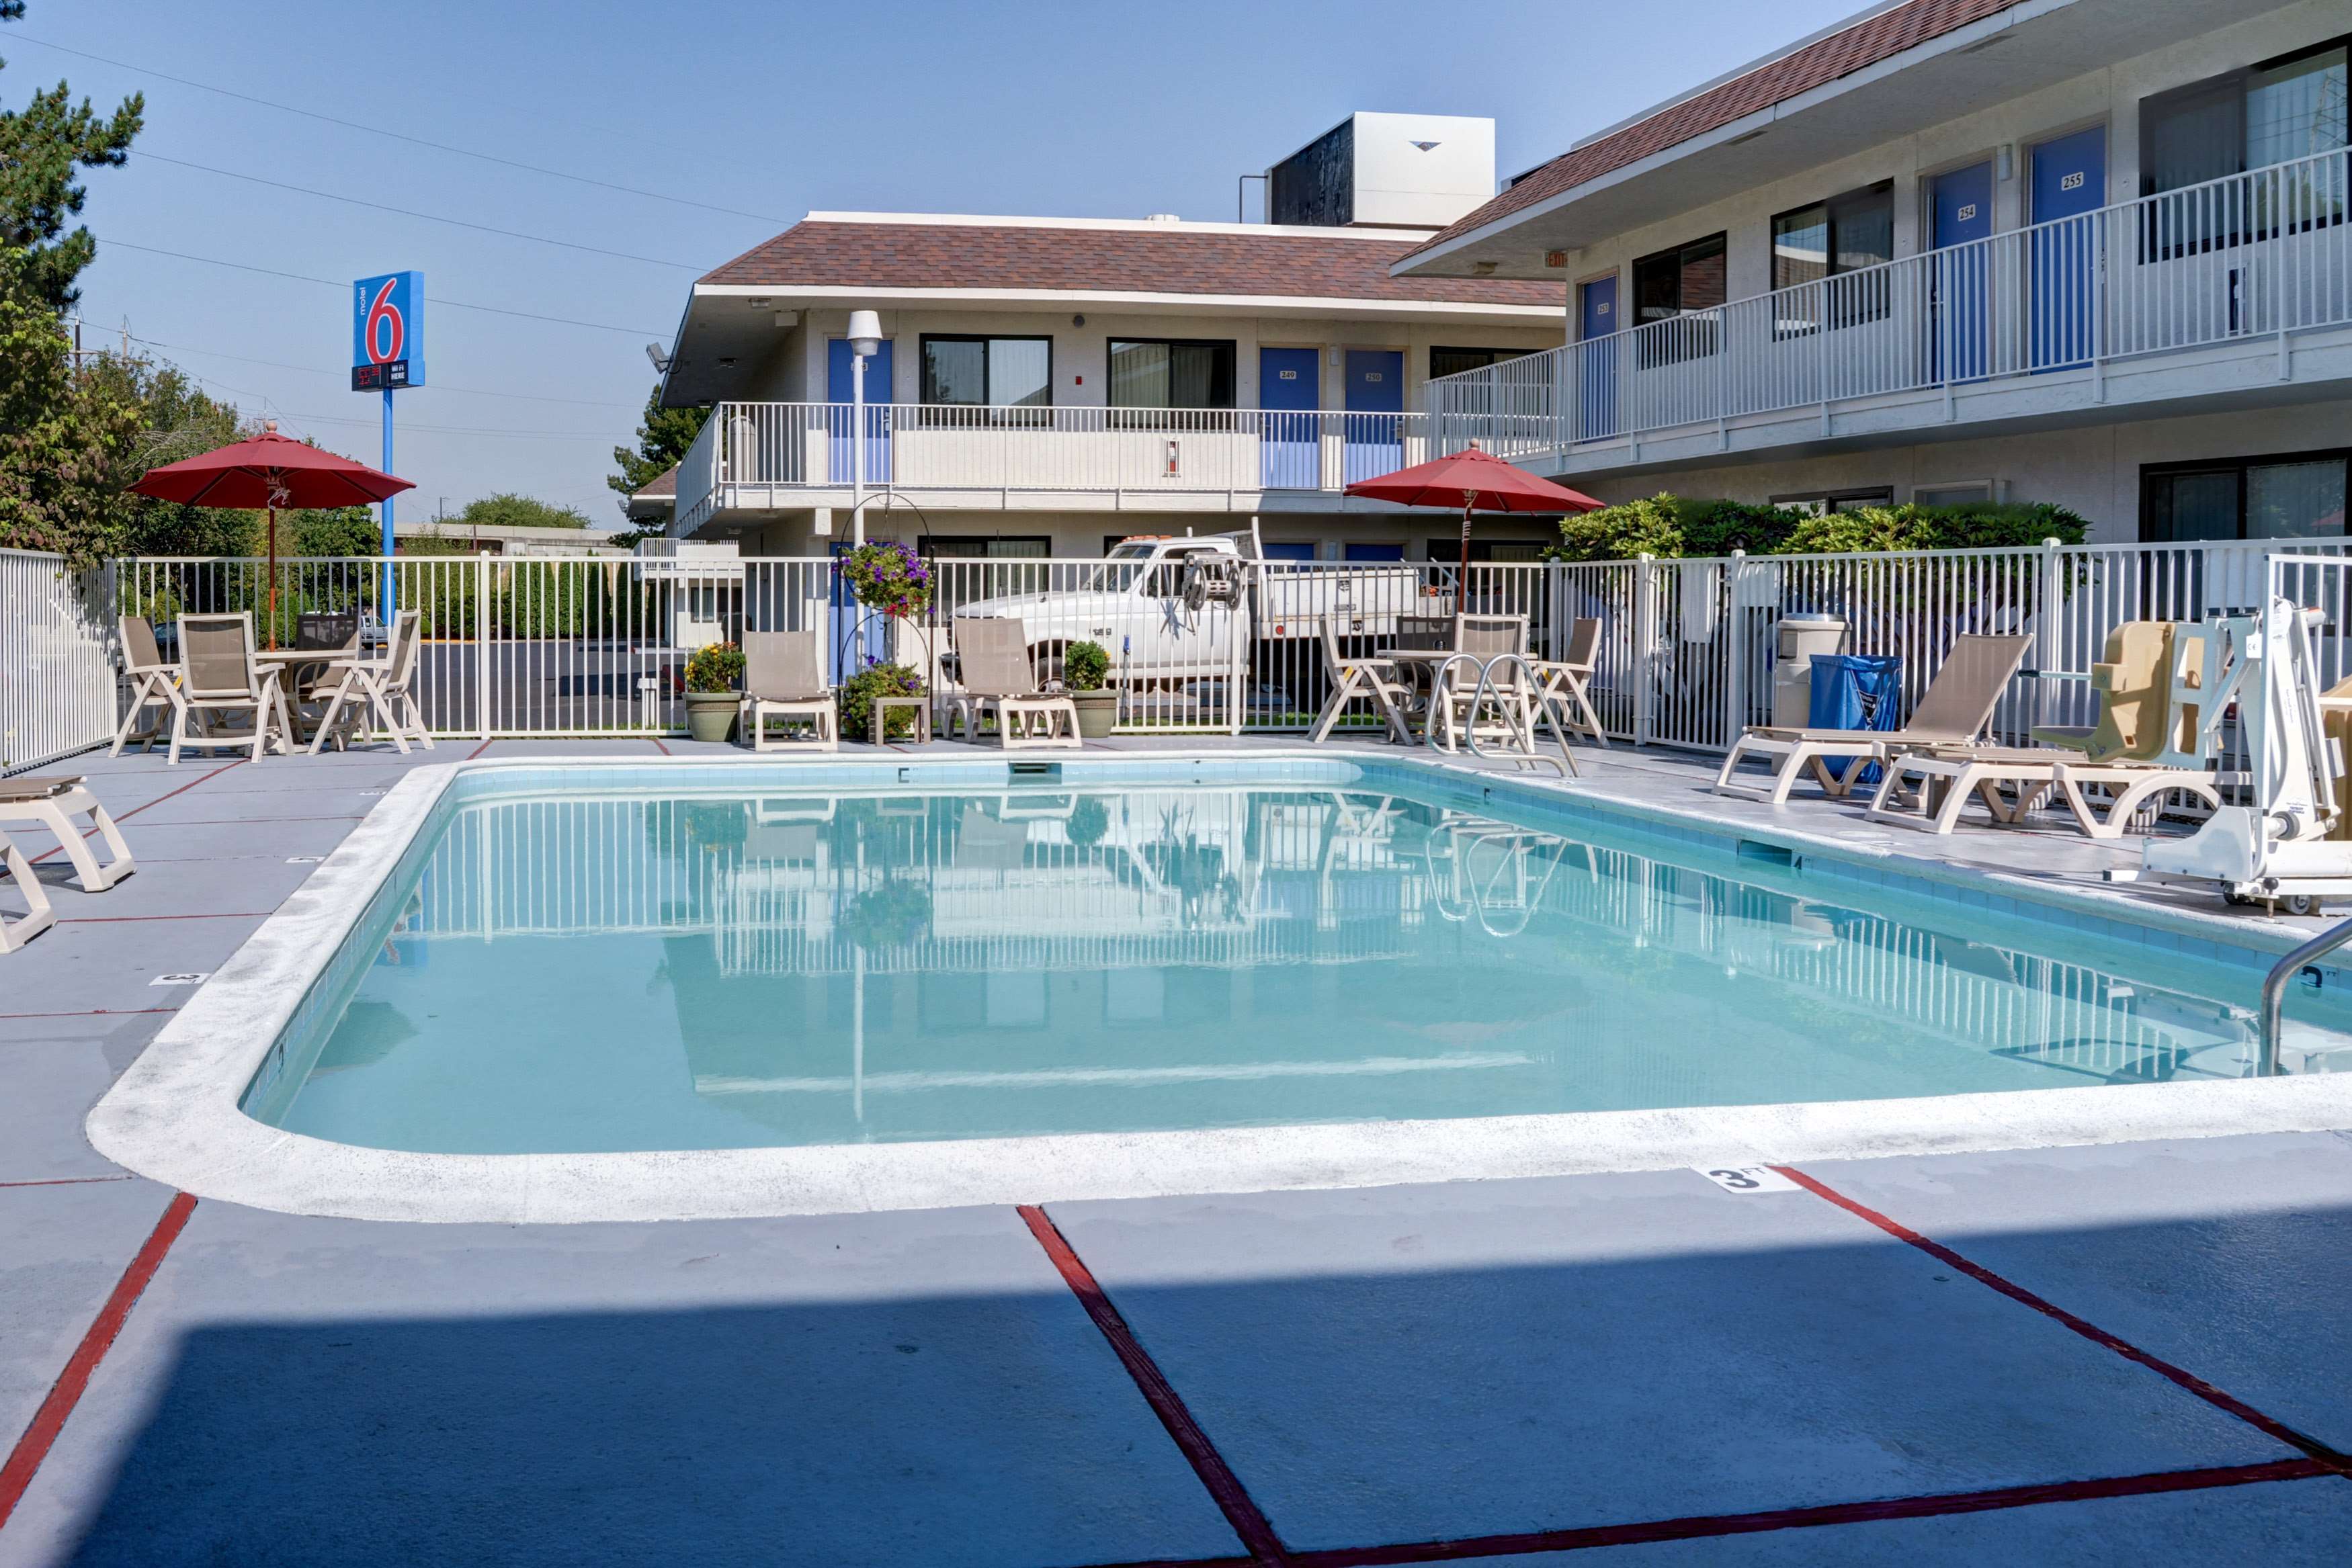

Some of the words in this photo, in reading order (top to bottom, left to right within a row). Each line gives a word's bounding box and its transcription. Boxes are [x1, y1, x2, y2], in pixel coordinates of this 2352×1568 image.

[2064, 173, 2081, 189] 255
[1960, 206, 1974, 219] 254
[1548, 253, 1566, 267] EXIT
[365, 277, 404, 365] 6
[391, 372, 405, 380] HERE
[1709, 1170, 1760, 1188] 3
[1740, 1167, 1766, 1175] FT
